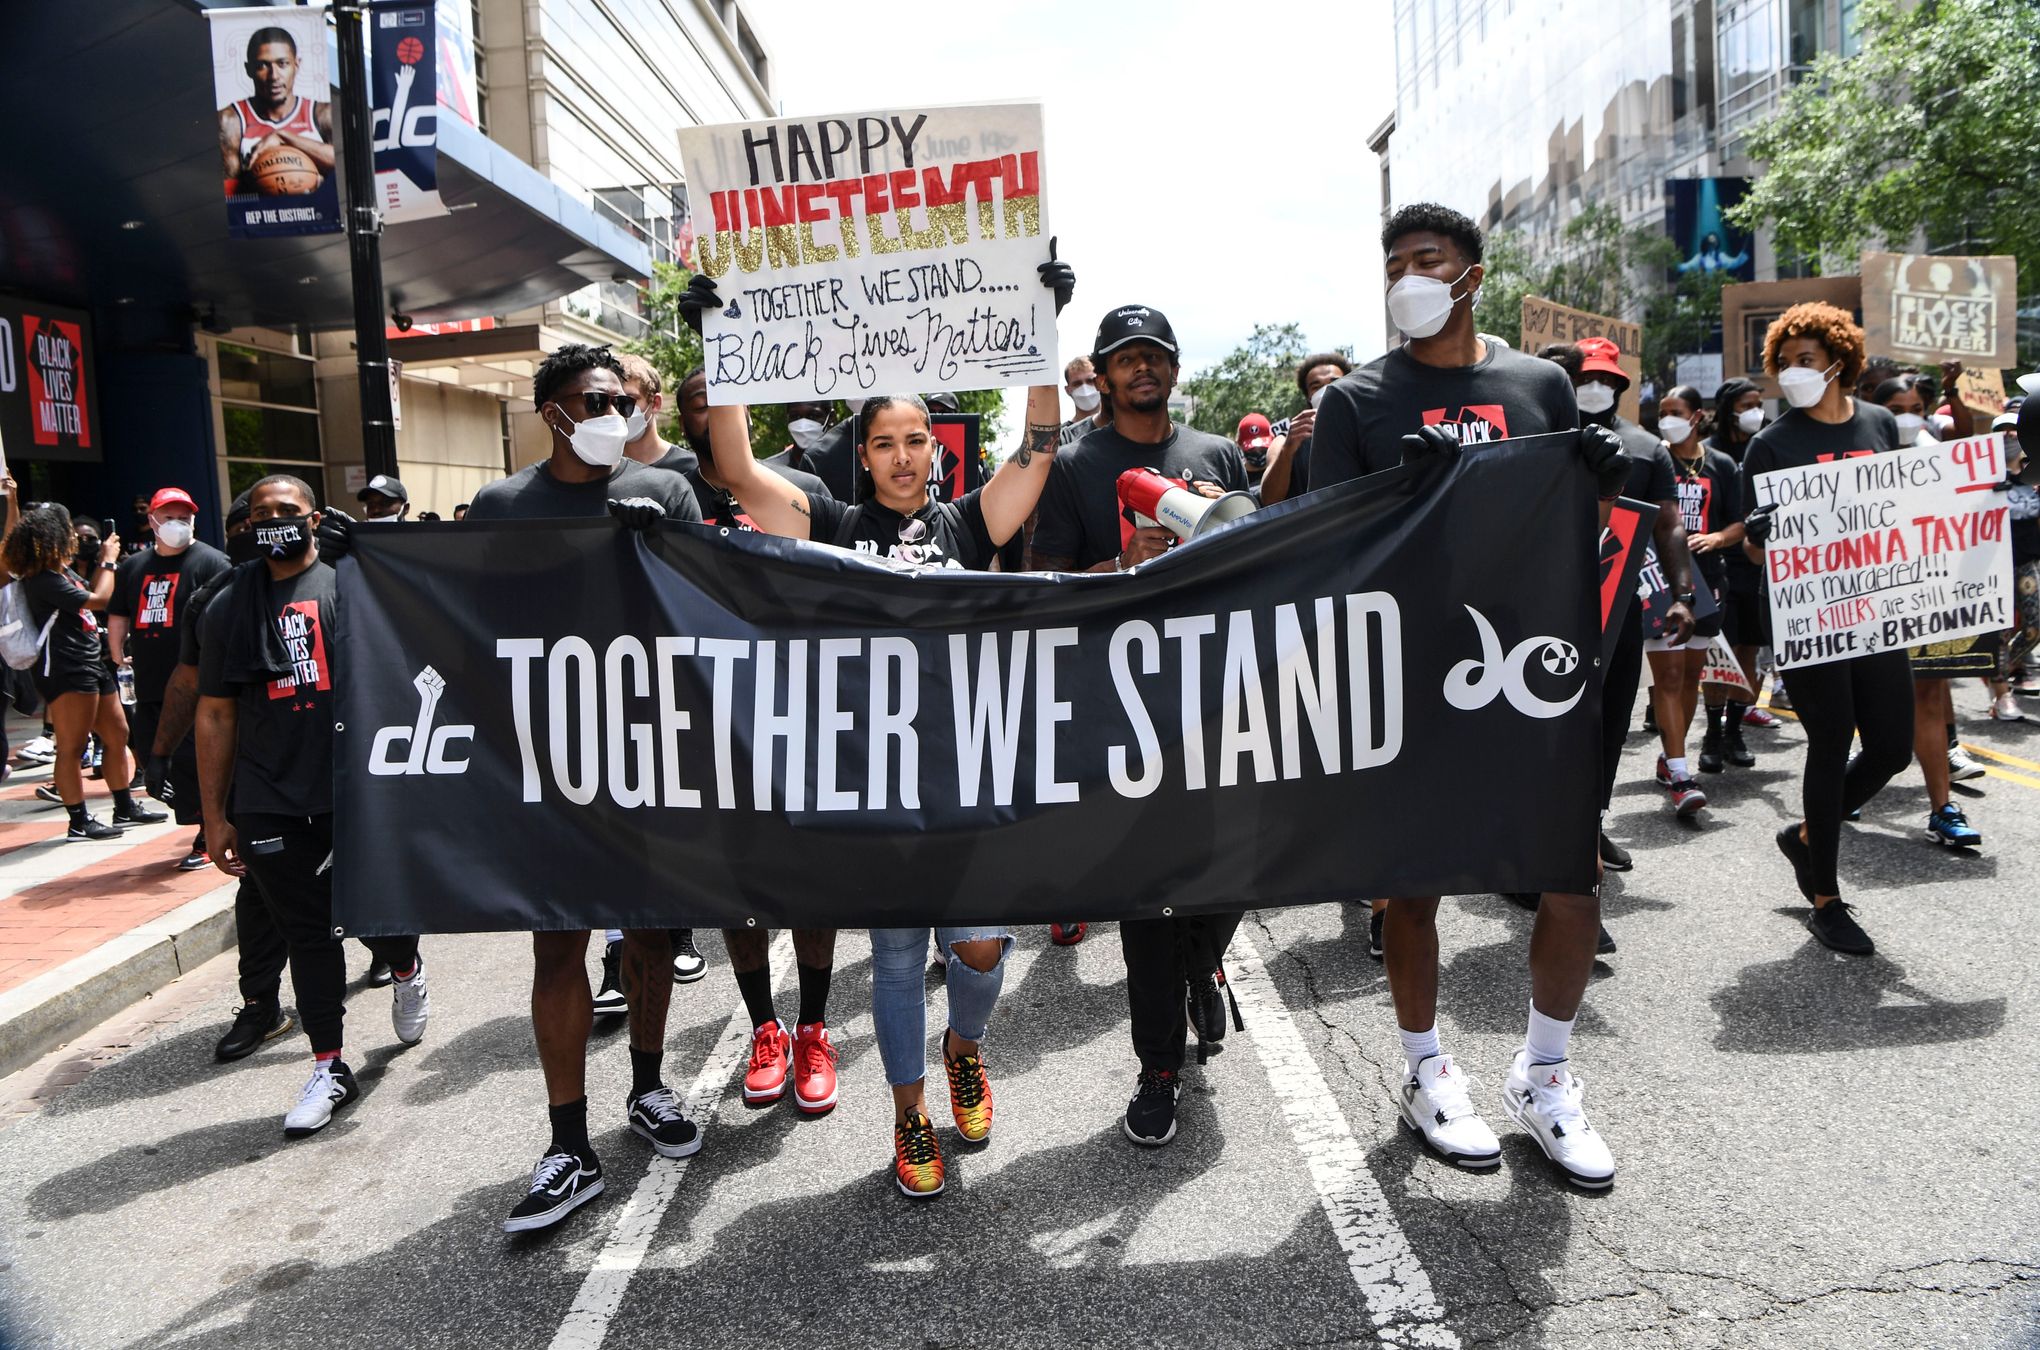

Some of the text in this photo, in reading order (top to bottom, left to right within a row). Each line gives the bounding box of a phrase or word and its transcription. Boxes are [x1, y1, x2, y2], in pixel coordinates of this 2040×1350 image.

[742, 114, 928, 185] HAPPY
[921, 134, 970, 162] June
[245, 207, 316, 225] REP THE DISTRICT
[697, 151, 1040, 279] JUNETEENTH
[744, 279, 849, 323] TOGETHER
[861, 269, 905, 306] WE
[1900, 297, 1987, 320] BLACK
[1127, 317, 1143, 327] City
[1900, 311, 1987, 338] LIVES
[37, 334, 72, 370] BLACK
[705, 303, 1040, 395] Black Lives Matter!
[1606, 324, 1641, 357] ALL
[1899, 330, 1988, 351] MATTER
[42, 368, 72, 402] LIVES
[39, 400, 82, 434] MATTER
[1677, 483, 1703, 499] BLACK
[1760, 438, 1997, 512] today makes 94
[1679, 498, 1701, 515] LIVES
[1768, 499, 1897, 545] days since
[1682, 515, 1703, 531] TTER
[1769, 527, 1908, 583] BREONNA
[147, 594, 167, 609] LIVES
[148, 581, 172, 595] BLACK
[1774, 579, 1816, 610] was
[1817, 596, 1877, 633] KILLERS
[1881, 597, 1904, 619] are
[1911, 584, 1946, 612] still
[1951, 574, 1999, 601] free!!
[140, 608, 168, 624] MATTER
[1775, 629, 1858, 667] JUSTICE
[1882, 596, 2006, 648] BREONNA!
[285, 637, 310, 662] VES
[495, 591, 1404, 812] TOGETHER WE STAND
